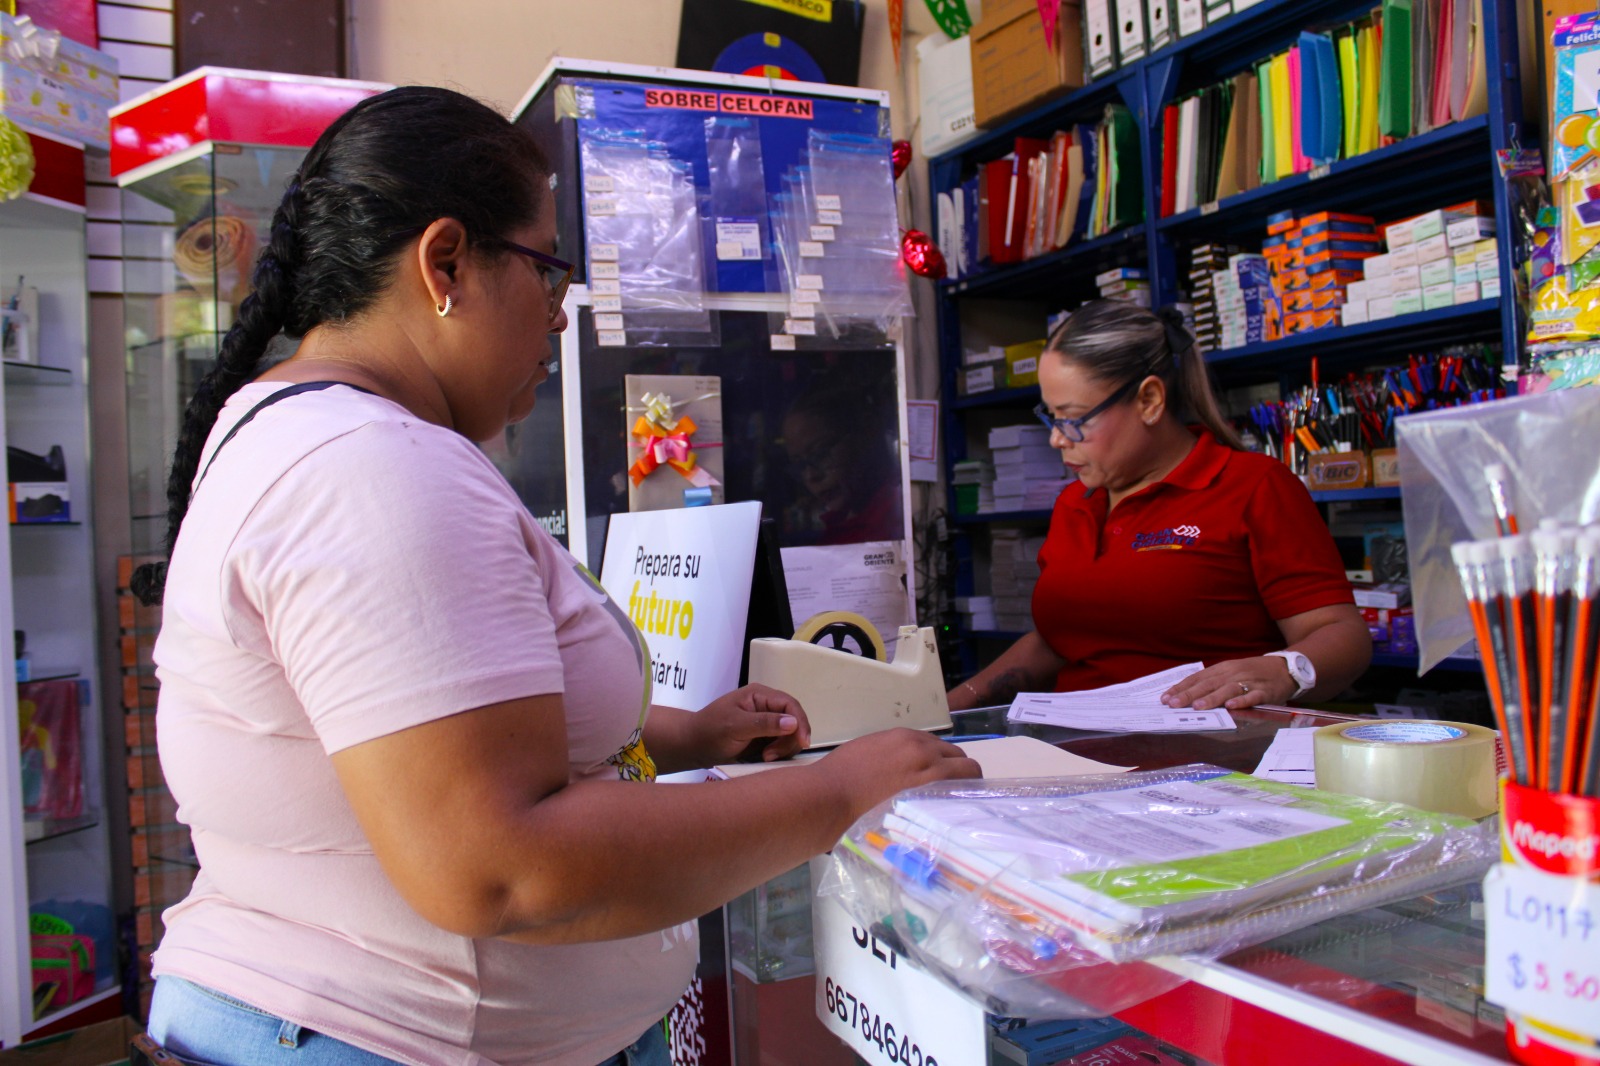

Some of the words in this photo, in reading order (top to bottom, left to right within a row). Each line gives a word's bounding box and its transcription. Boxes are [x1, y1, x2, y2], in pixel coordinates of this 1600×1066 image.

[1566, 32, 1600, 45] Felici
[647, 91, 716, 109] SOBRE
[722, 96, 811, 116] CELOFAN
[536, 509, 566, 535] ncia!
[634, 545, 681, 586] Prepara
[683, 554, 701, 579] su
[628, 579, 694, 640] futuro
[673, 660, 687, 691] tu
[825, 976, 938, 1066] 66784642
